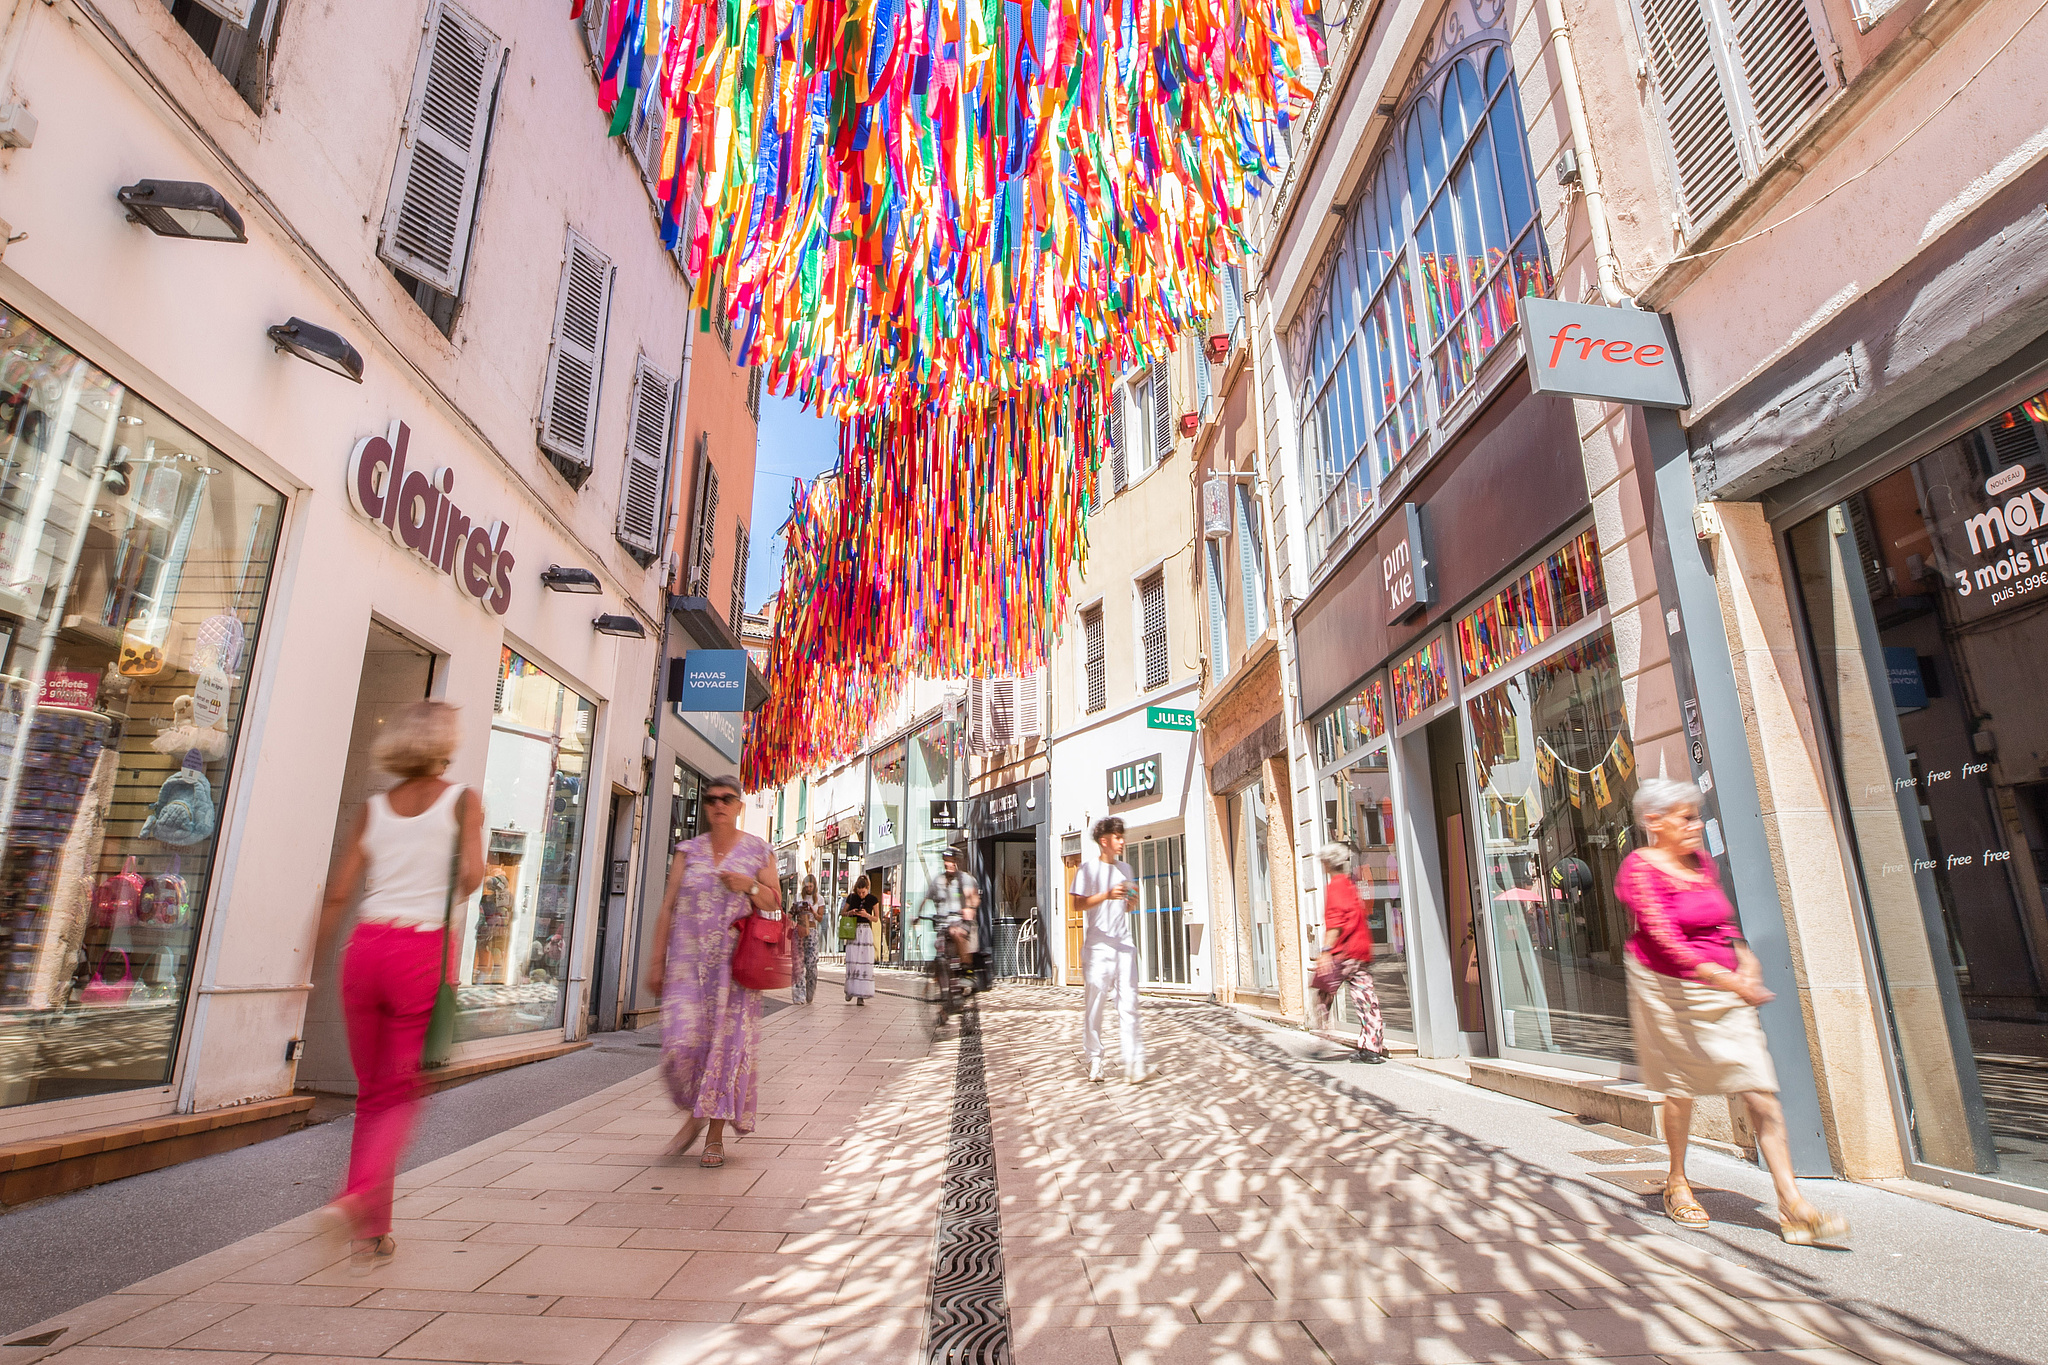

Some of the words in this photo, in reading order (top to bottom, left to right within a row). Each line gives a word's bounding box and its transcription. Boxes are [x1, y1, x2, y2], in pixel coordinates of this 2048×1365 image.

[1548, 323, 1665, 368] free
[1990, 471, 2021, 490] NOUVEAU
[350, 419, 516, 616] claire's
[1954, 569, 1973, 597] 3
[1974, 548, 2032, 591] mois
[1991, 586, 2015, 606] puis
[39, 679, 47, 687] 3
[49, 680, 89, 689] achetés
[689, 671, 727, 680] HAVAS
[689, 680, 740, 689] VOYAGES
[40, 688, 48, 696] 3
[1153, 712, 1193, 726] JULES
[1107, 760, 1156, 800] JULES
[1864, 783, 1886, 798] free
[1894, 775, 1918, 792] free
[1927, 769, 1952, 786] free
[1961, 762, 1989, 779] free
[1881, 862, 1904, 877] free
[1913, 858, 1937, 874] free
[1946, 854, 1973, 870] free
[1983, 849, 2011, 866] free
